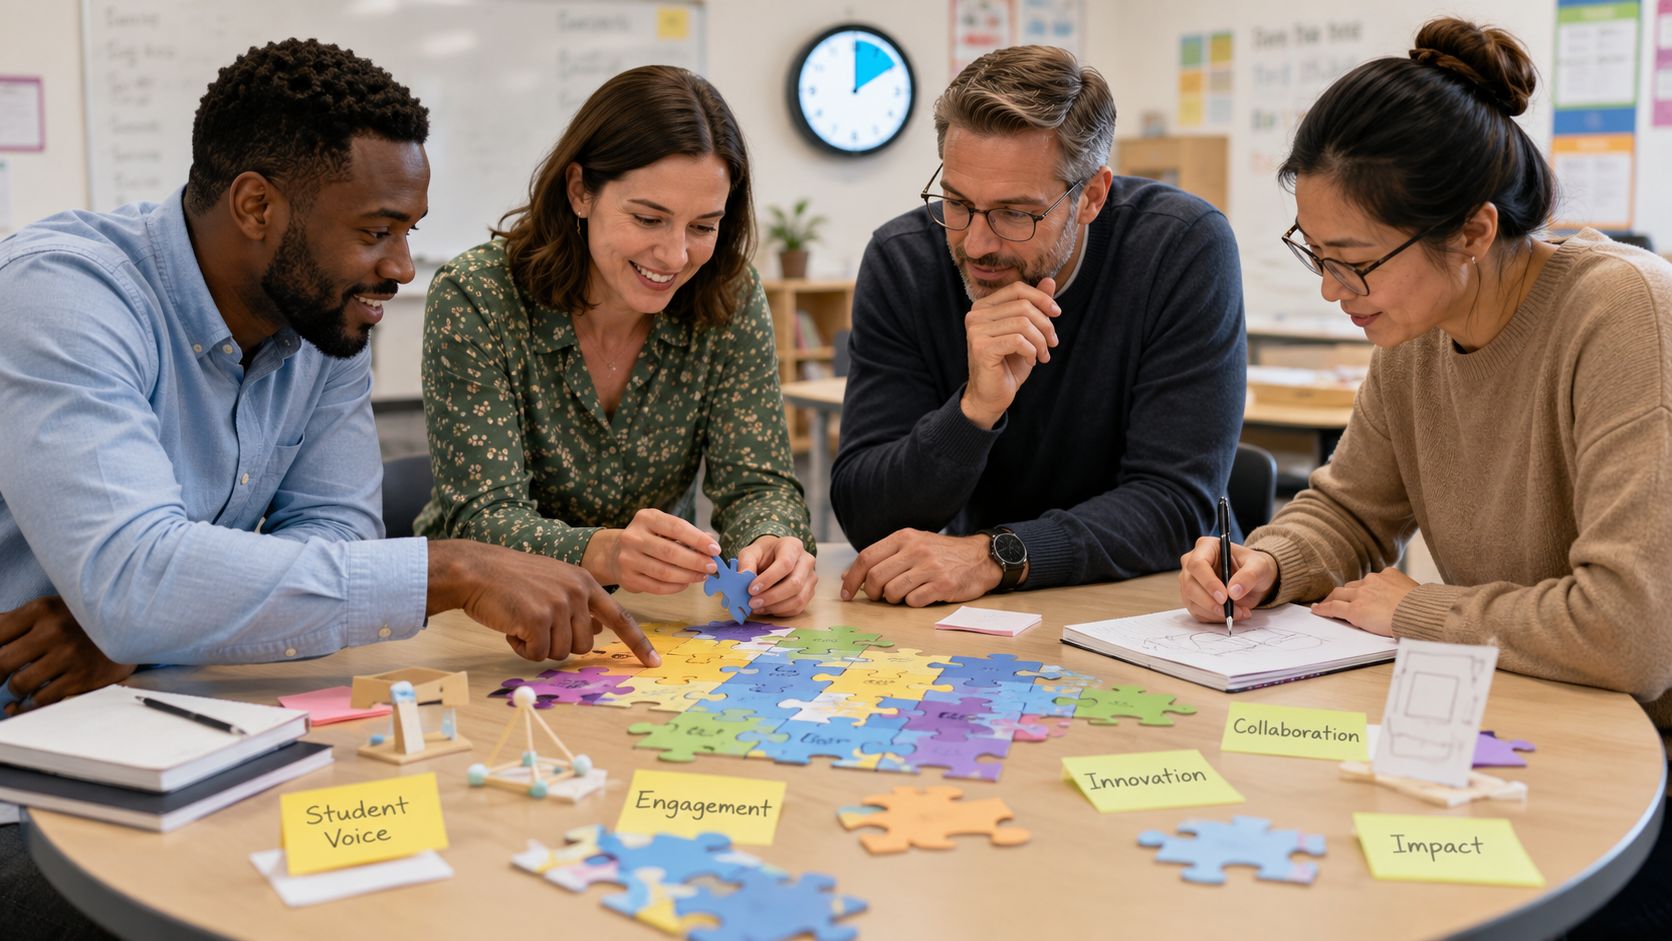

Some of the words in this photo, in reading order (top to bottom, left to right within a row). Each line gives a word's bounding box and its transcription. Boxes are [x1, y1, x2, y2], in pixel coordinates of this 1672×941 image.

[1233, 717, 1360, 743] Collaboration
[1084, 767, 1208, 791] Innovation
[306, 795, 410, 826] Student
[635, 789, 773, 820] Engagement
[324, 825, 392, 849] Voice
[1390, 833, 1484, 862] Impact
